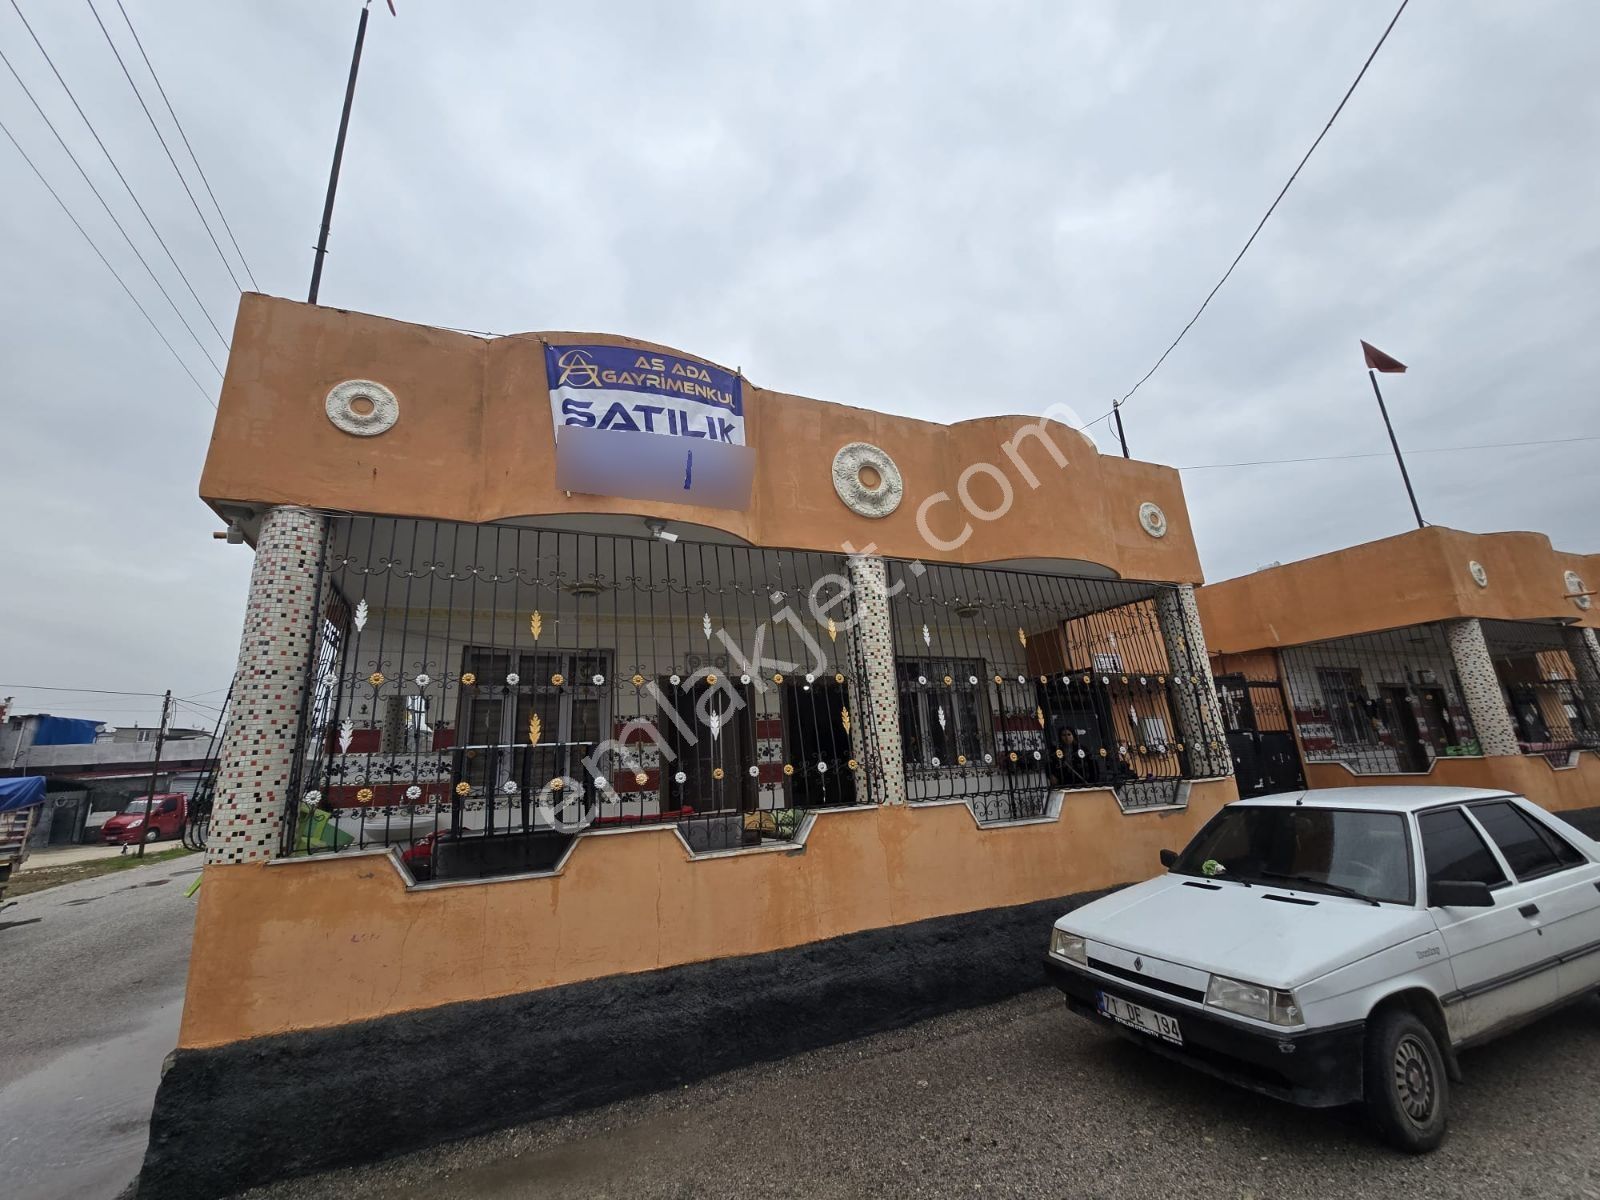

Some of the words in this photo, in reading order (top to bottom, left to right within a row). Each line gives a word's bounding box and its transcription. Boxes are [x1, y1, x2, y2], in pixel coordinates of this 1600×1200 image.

[601, 370, 736, 409] GAYRİMENKUL
[634, 356, 666, 372] AS
[671, 362, 713, 384] ADA
[562, 398, 736, 445] SATILIK
[1103, 993, 1118, 1015] 71
[1126, 1003, 1145, 1026] DE
[1153, 1013, 1180, 1038] 194
